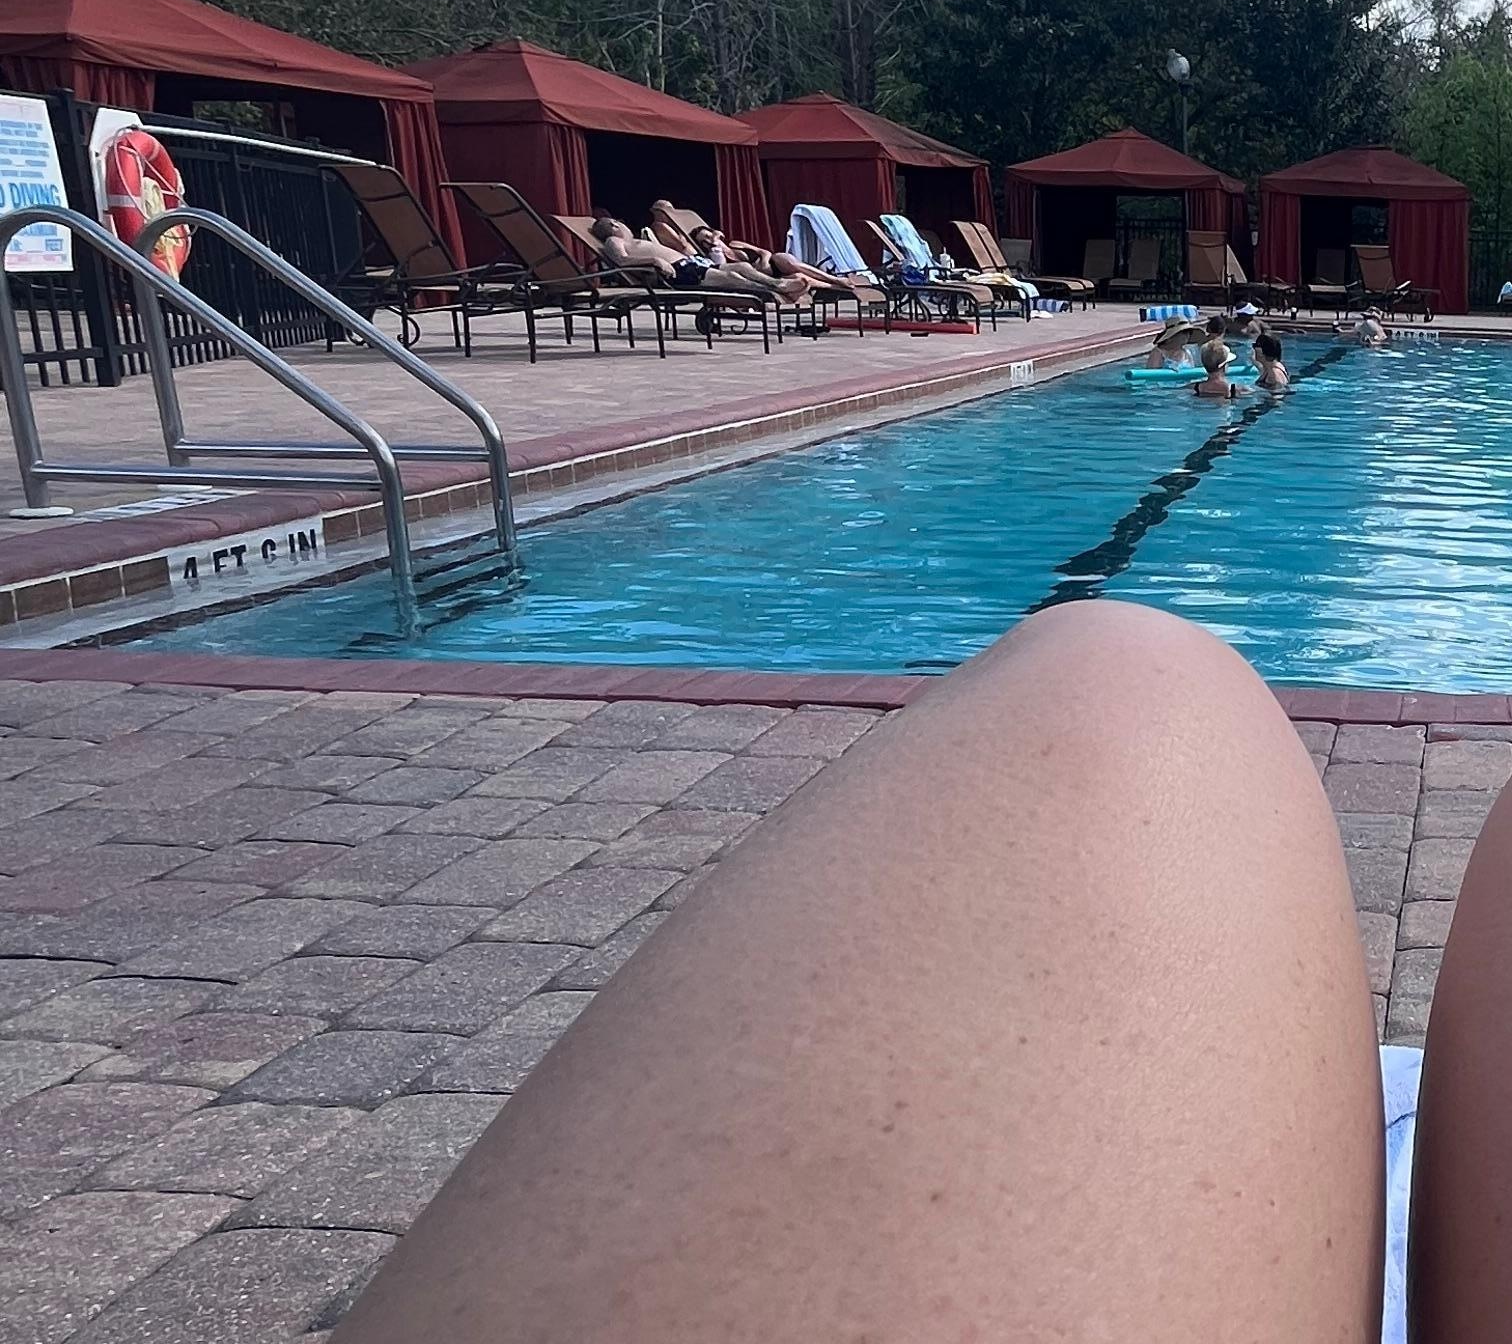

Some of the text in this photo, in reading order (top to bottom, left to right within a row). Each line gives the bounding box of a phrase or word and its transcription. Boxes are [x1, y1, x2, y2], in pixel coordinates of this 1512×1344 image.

[9, 182, 61, 207] DIVING
[212, 544, 247, 573] FT
[288, 528, 317, 554] IN
